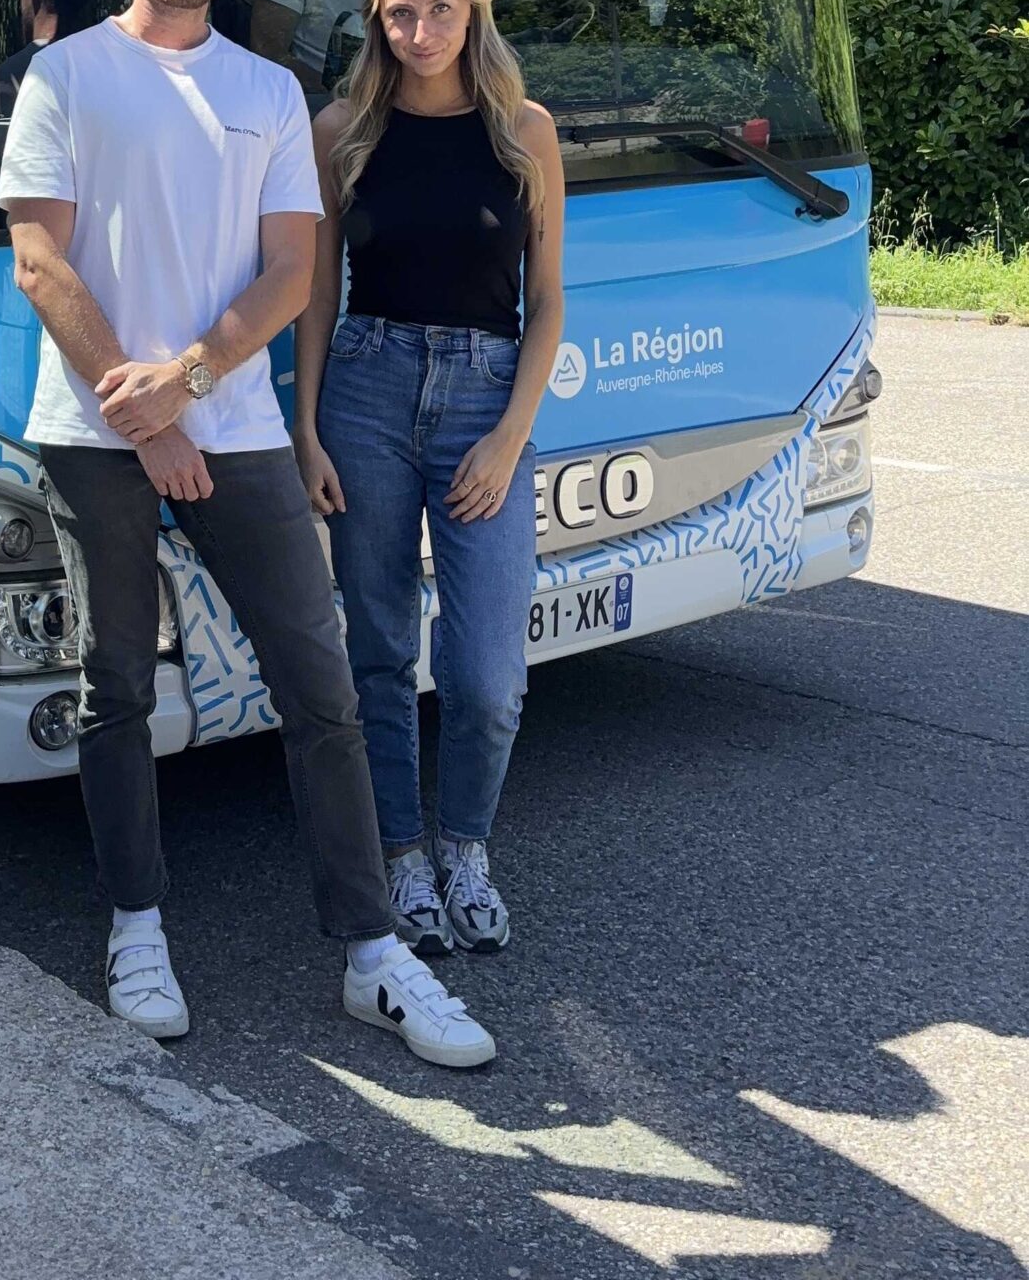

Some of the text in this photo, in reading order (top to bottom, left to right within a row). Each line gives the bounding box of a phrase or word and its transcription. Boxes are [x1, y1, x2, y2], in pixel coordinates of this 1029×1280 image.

[593, 322, 723, 369] La Région
[595, 361, 724, 394] Auvergne-Rhône-Alpes
[616, 602, 630, 622] 07
